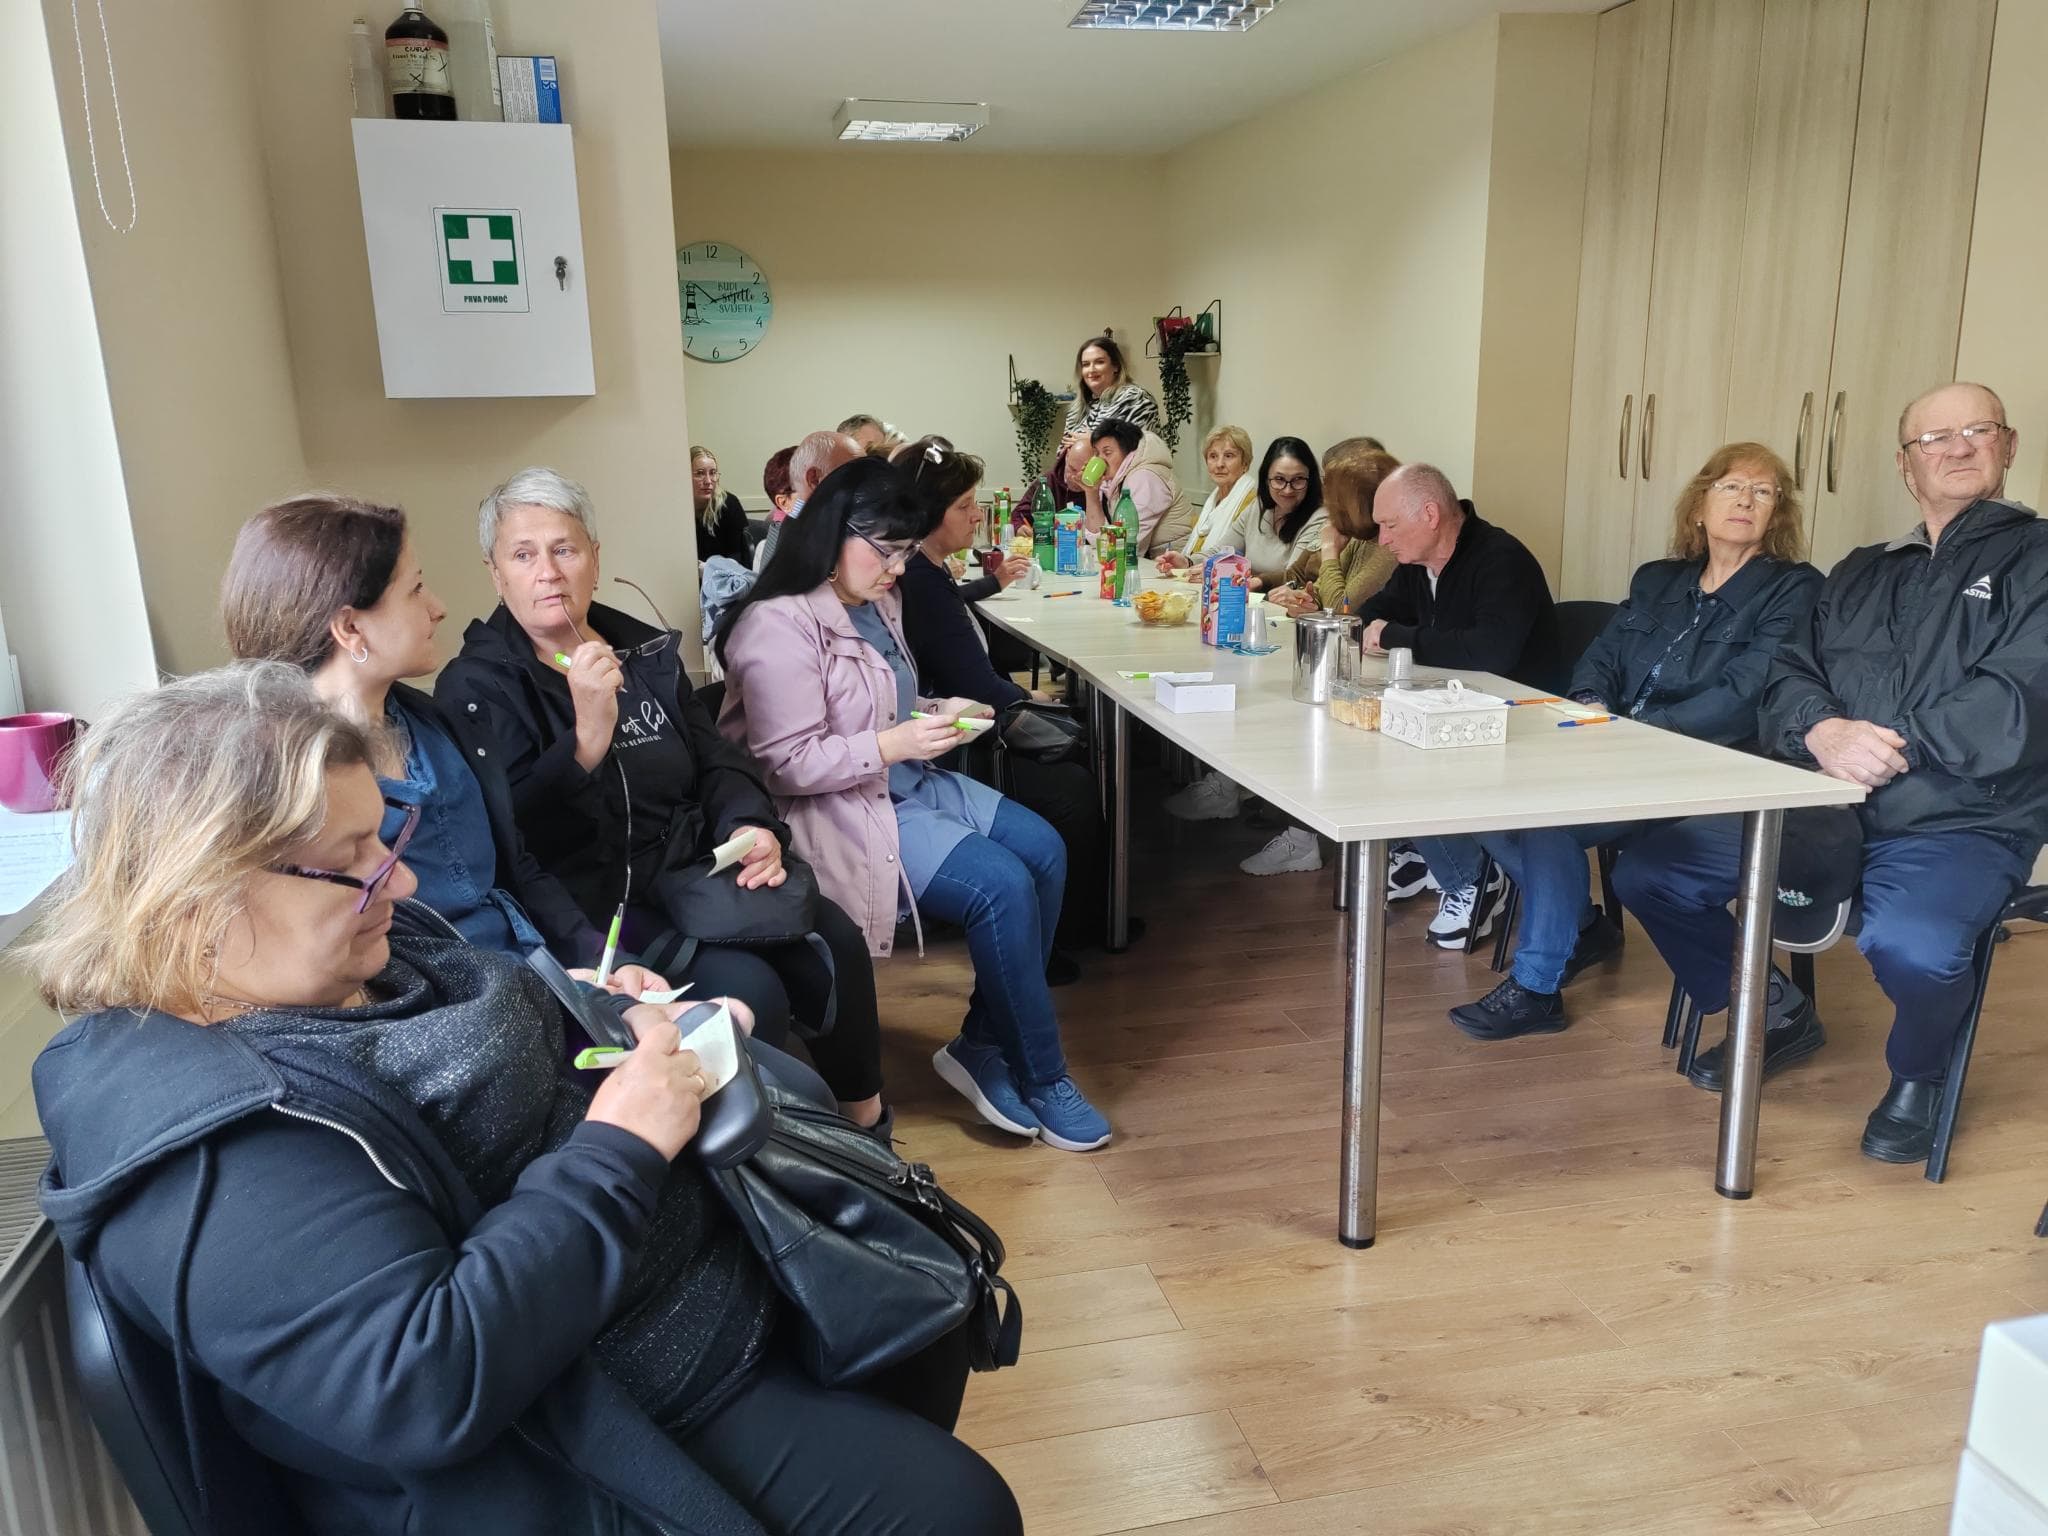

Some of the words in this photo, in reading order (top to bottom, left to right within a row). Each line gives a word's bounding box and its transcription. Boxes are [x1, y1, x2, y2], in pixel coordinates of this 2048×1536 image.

[683, 251, 691, 265] 11
[705, 244, 718, 259] 12
[753, 271, 760, 285] 2
[463, 295, 482, 303] PRVA
[762, 291, 770, 305] 3
[719, 303, 753, 314] SVIJETA
[755, 316, 763, 329] 4
[687, 336, 693, 350] 7
[739, 338, 748, 351] 5
[712, 346, 720, 360] 6
[1962, 588, 1993, 600] ASTRA
[629, 735, 662, 747] BEAUTIFUL
